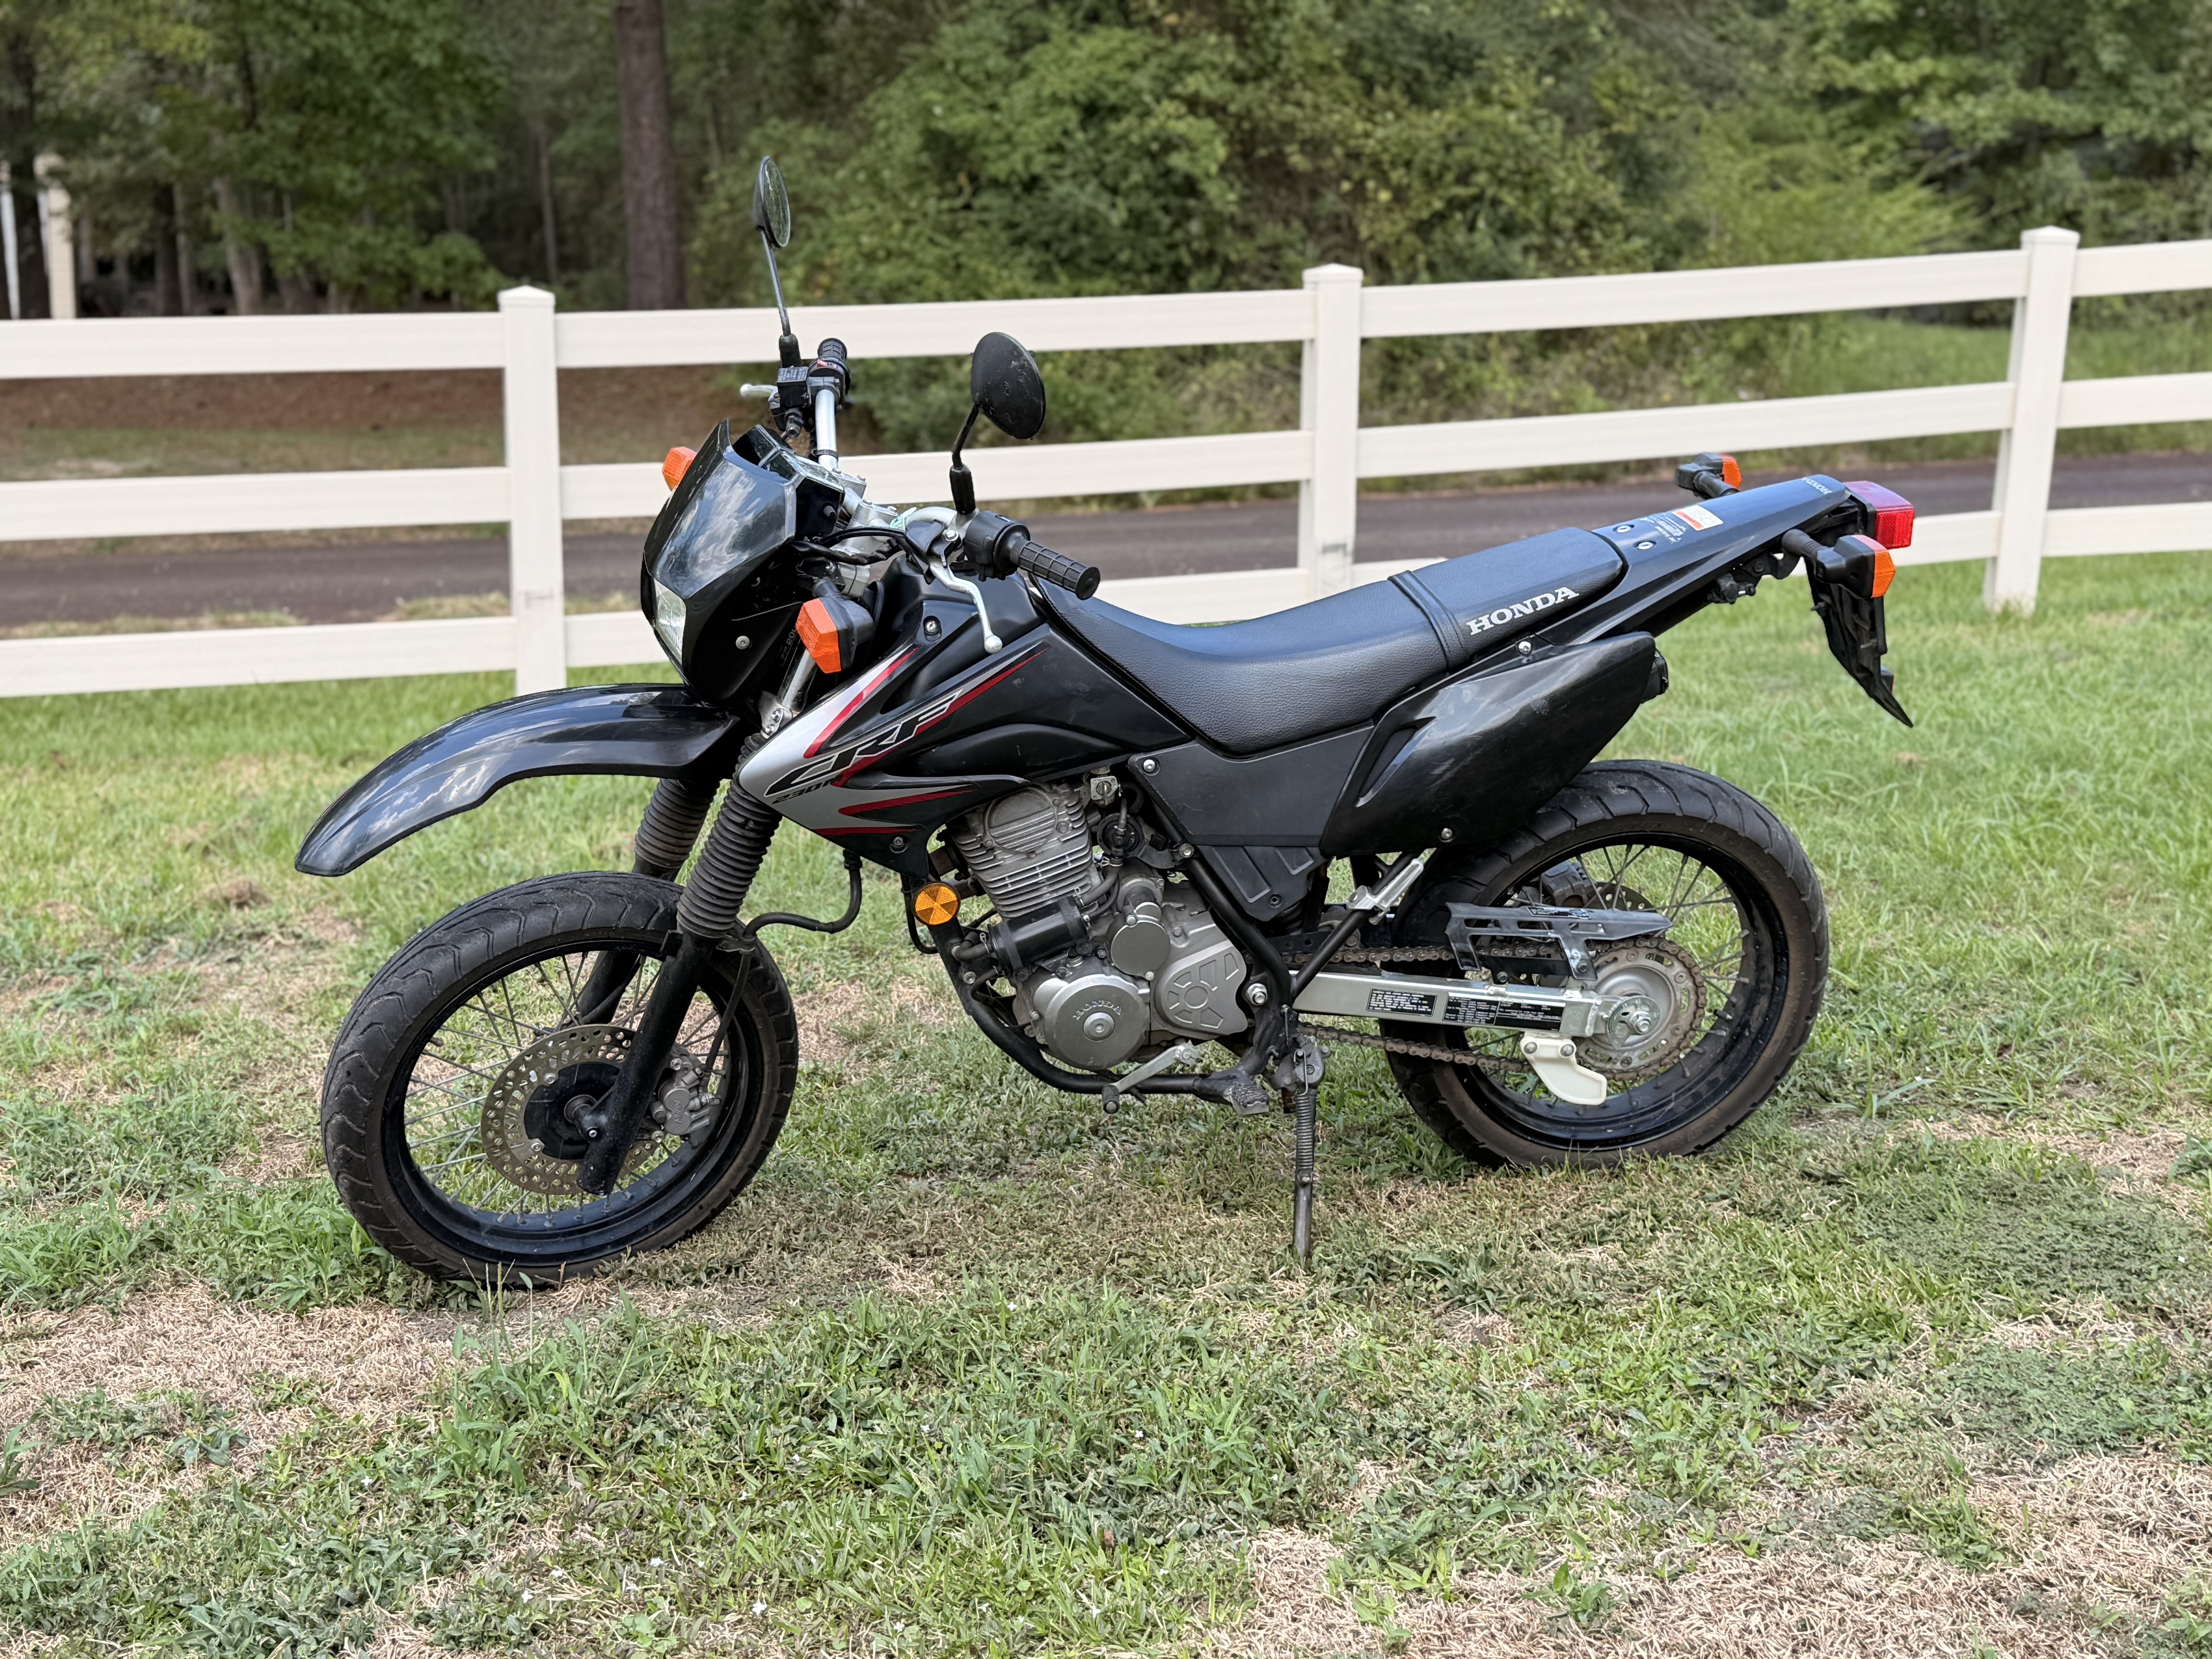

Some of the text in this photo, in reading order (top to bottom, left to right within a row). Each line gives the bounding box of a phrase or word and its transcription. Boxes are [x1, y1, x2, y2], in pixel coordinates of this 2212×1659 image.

[1466, 587, 1580, 635] HONDA
[763, 689, 963, 797] CRF
[1073, 1000, 1122, 1020] HONDA
